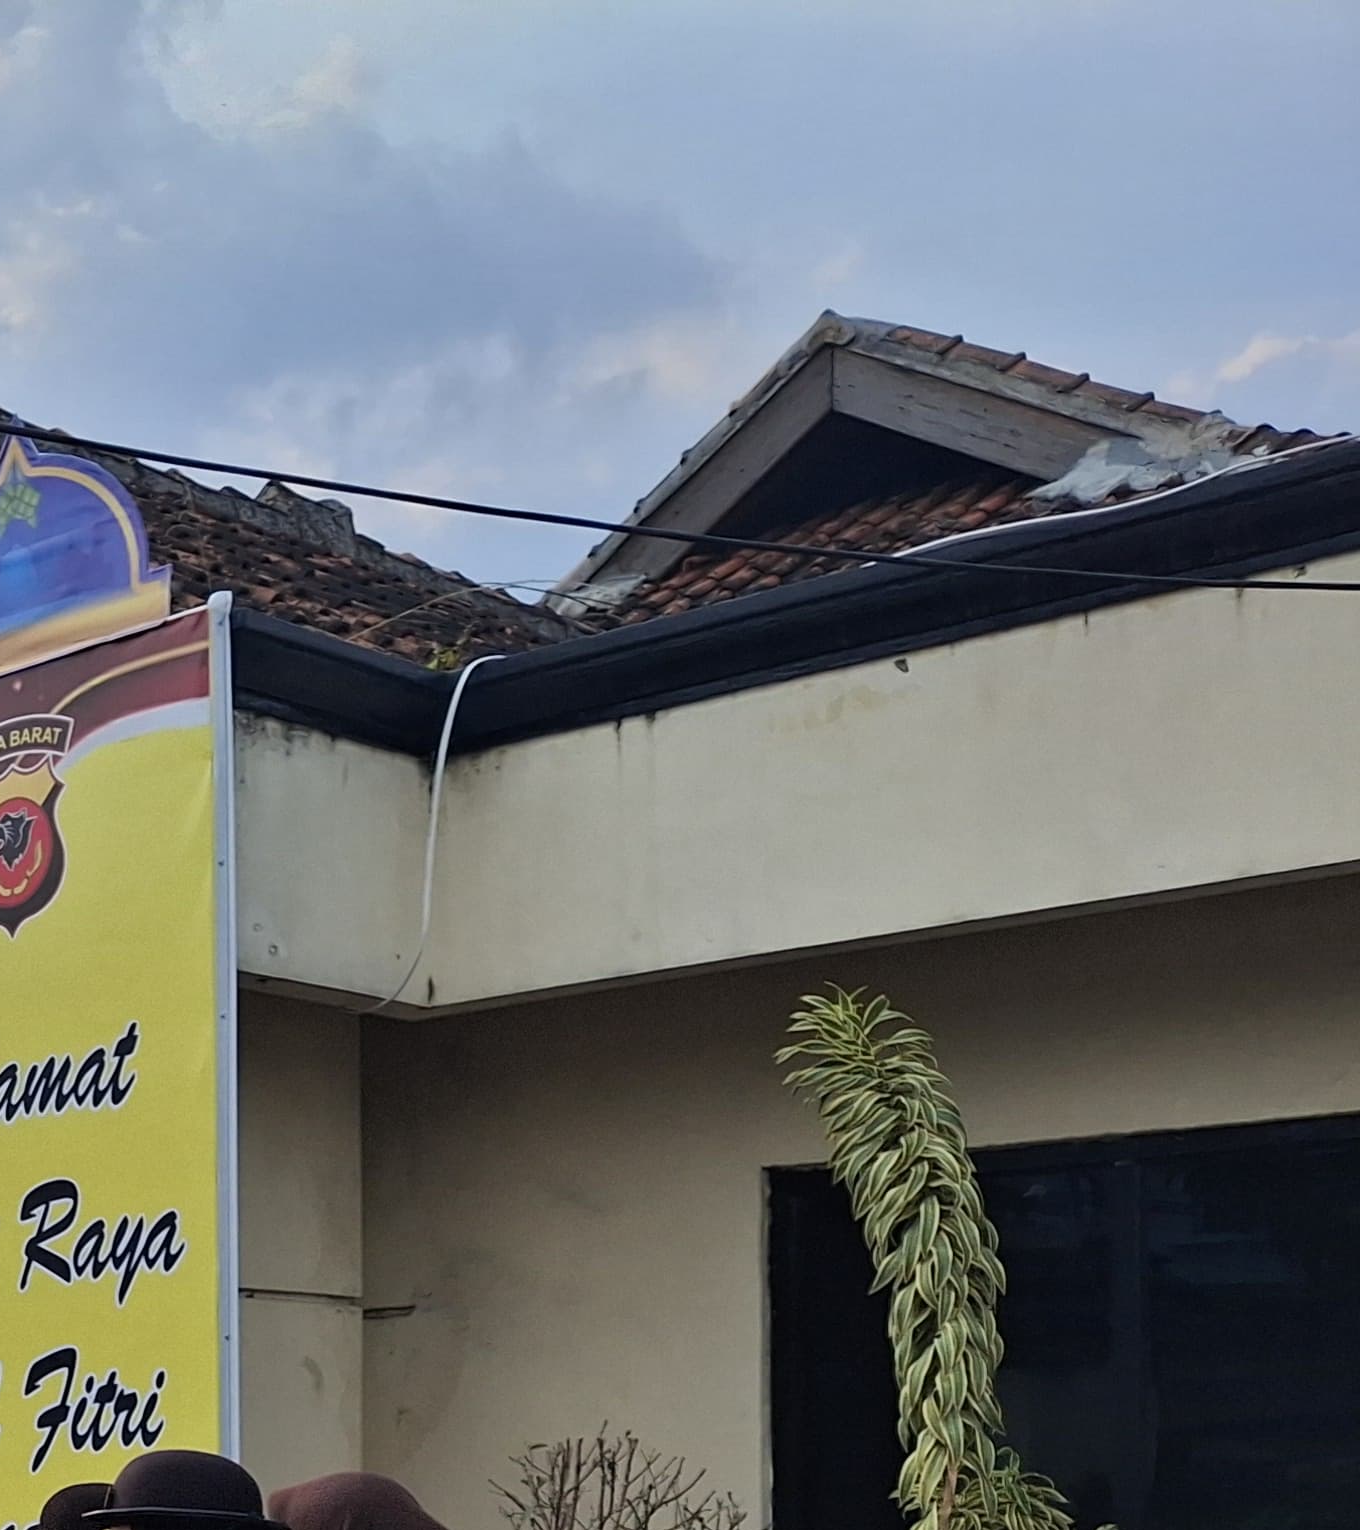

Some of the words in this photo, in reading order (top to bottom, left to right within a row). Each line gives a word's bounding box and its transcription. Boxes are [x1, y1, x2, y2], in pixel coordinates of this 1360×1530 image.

[8, 727, 63, 749] BARAT
[19, 1179, 185, 1305] Raya
[24, 1347, 166, 1473] Fitri
